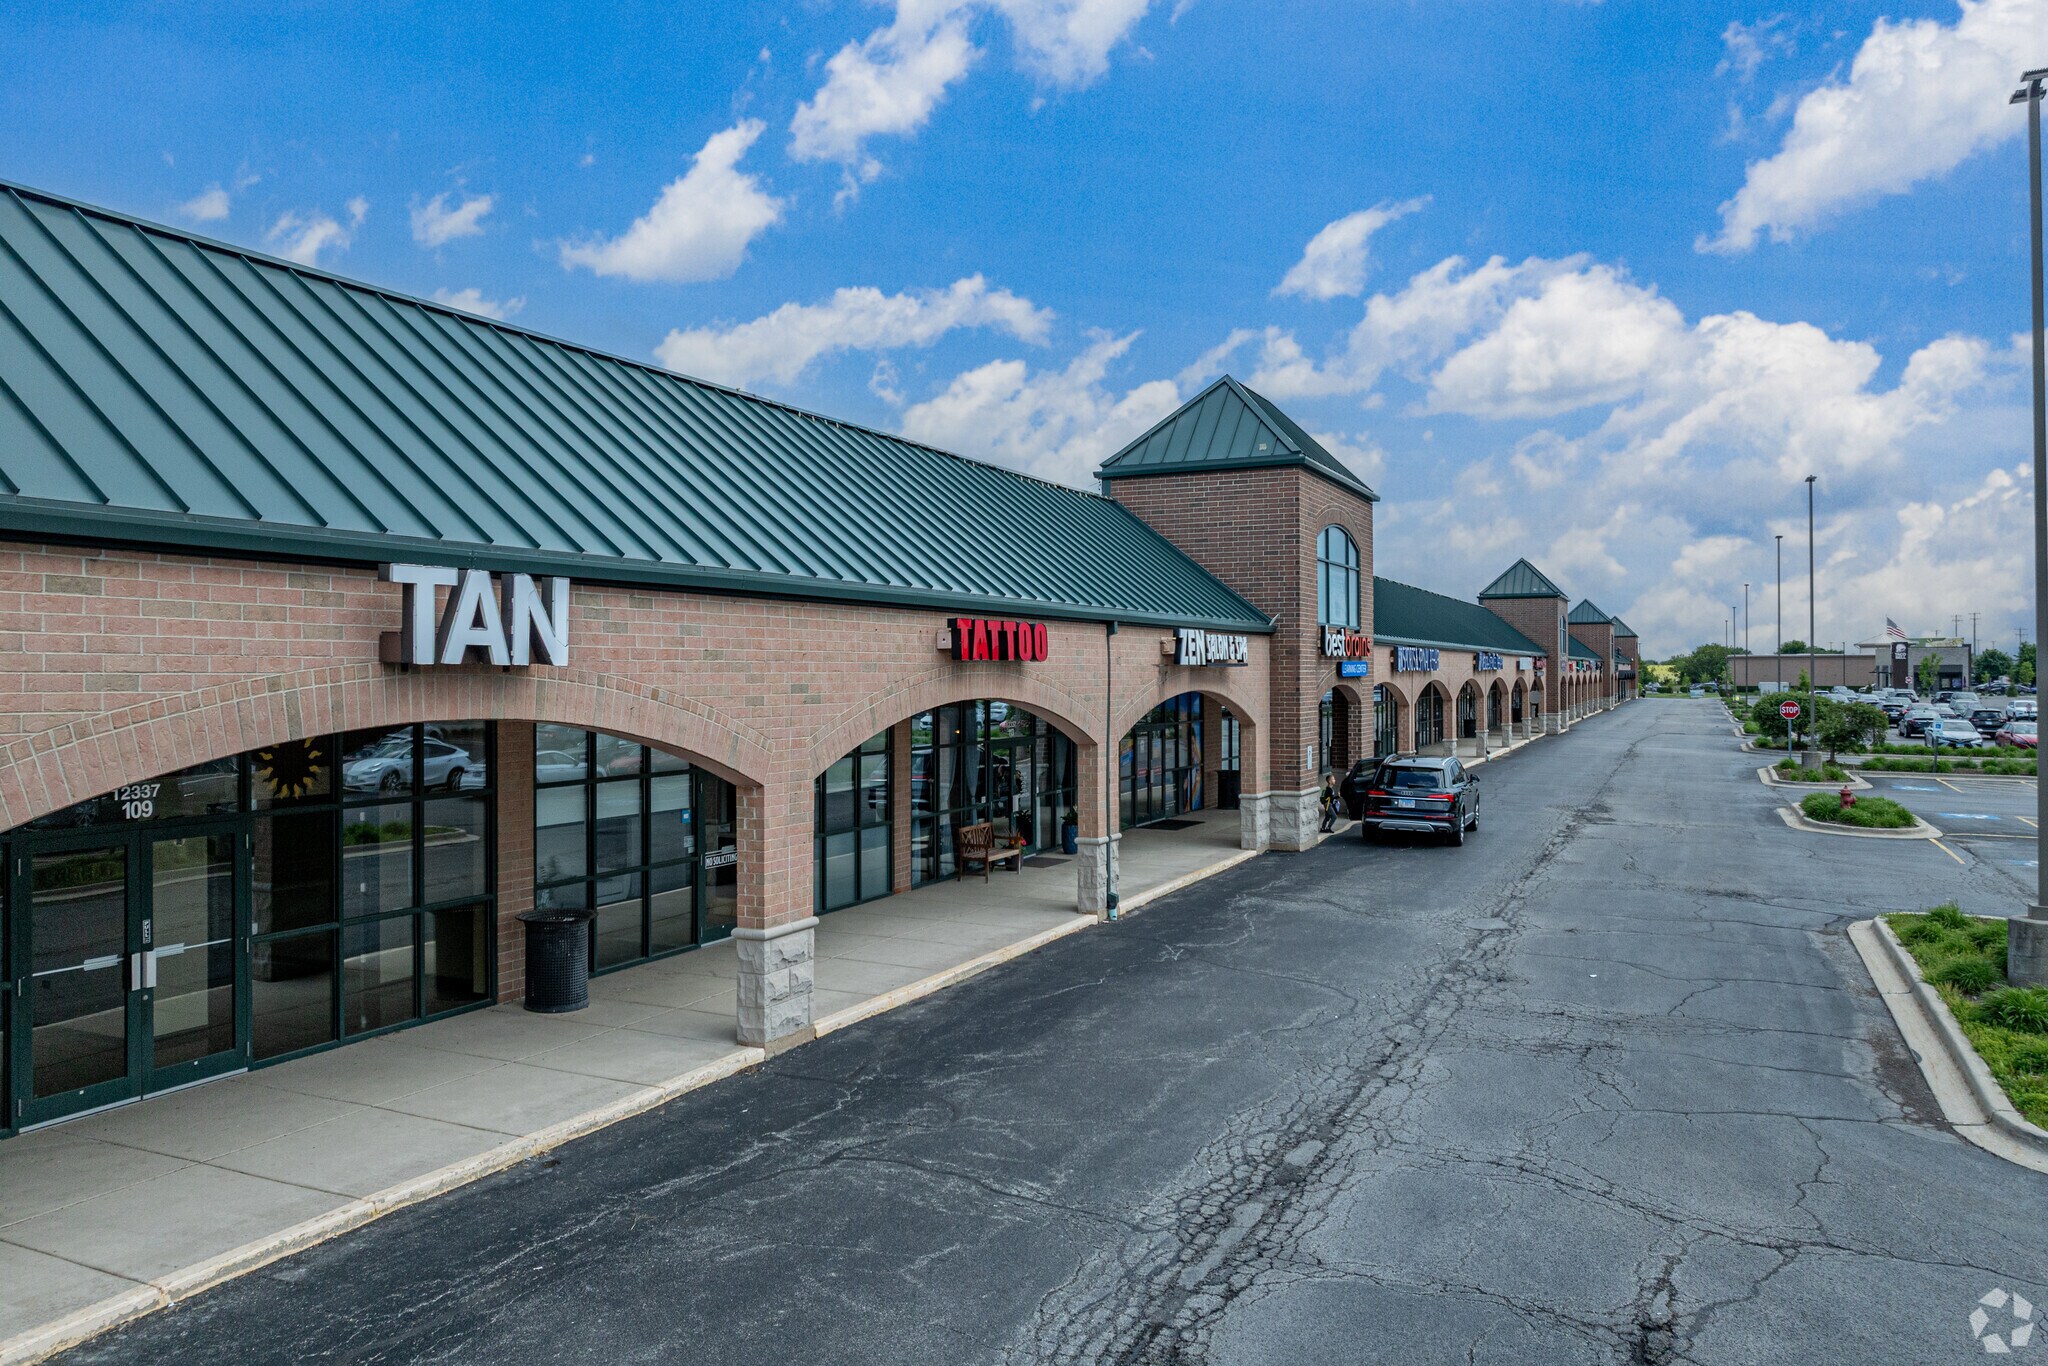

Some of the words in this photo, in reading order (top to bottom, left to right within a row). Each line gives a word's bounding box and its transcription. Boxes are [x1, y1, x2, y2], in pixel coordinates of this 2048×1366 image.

[390, 563, 570, 667] TAN
[957, 618, 1048, 662] TATTOO
[1179, 628, 1206, 666] ZEN
[1205, 634, 1229, 663] SALON
[1229, 635, 1235, 660] &
[1235, 636, 1248, 663] SPA
[1325, 624, 1346, 656] best
[1345, 629, 1371, 657] brains
[1781, 706, 1799, 714] STOP
[112, 784, 161, 801] 12337
[122, 800, 153, 820] 109
[706, 857, 713, 867] NO
